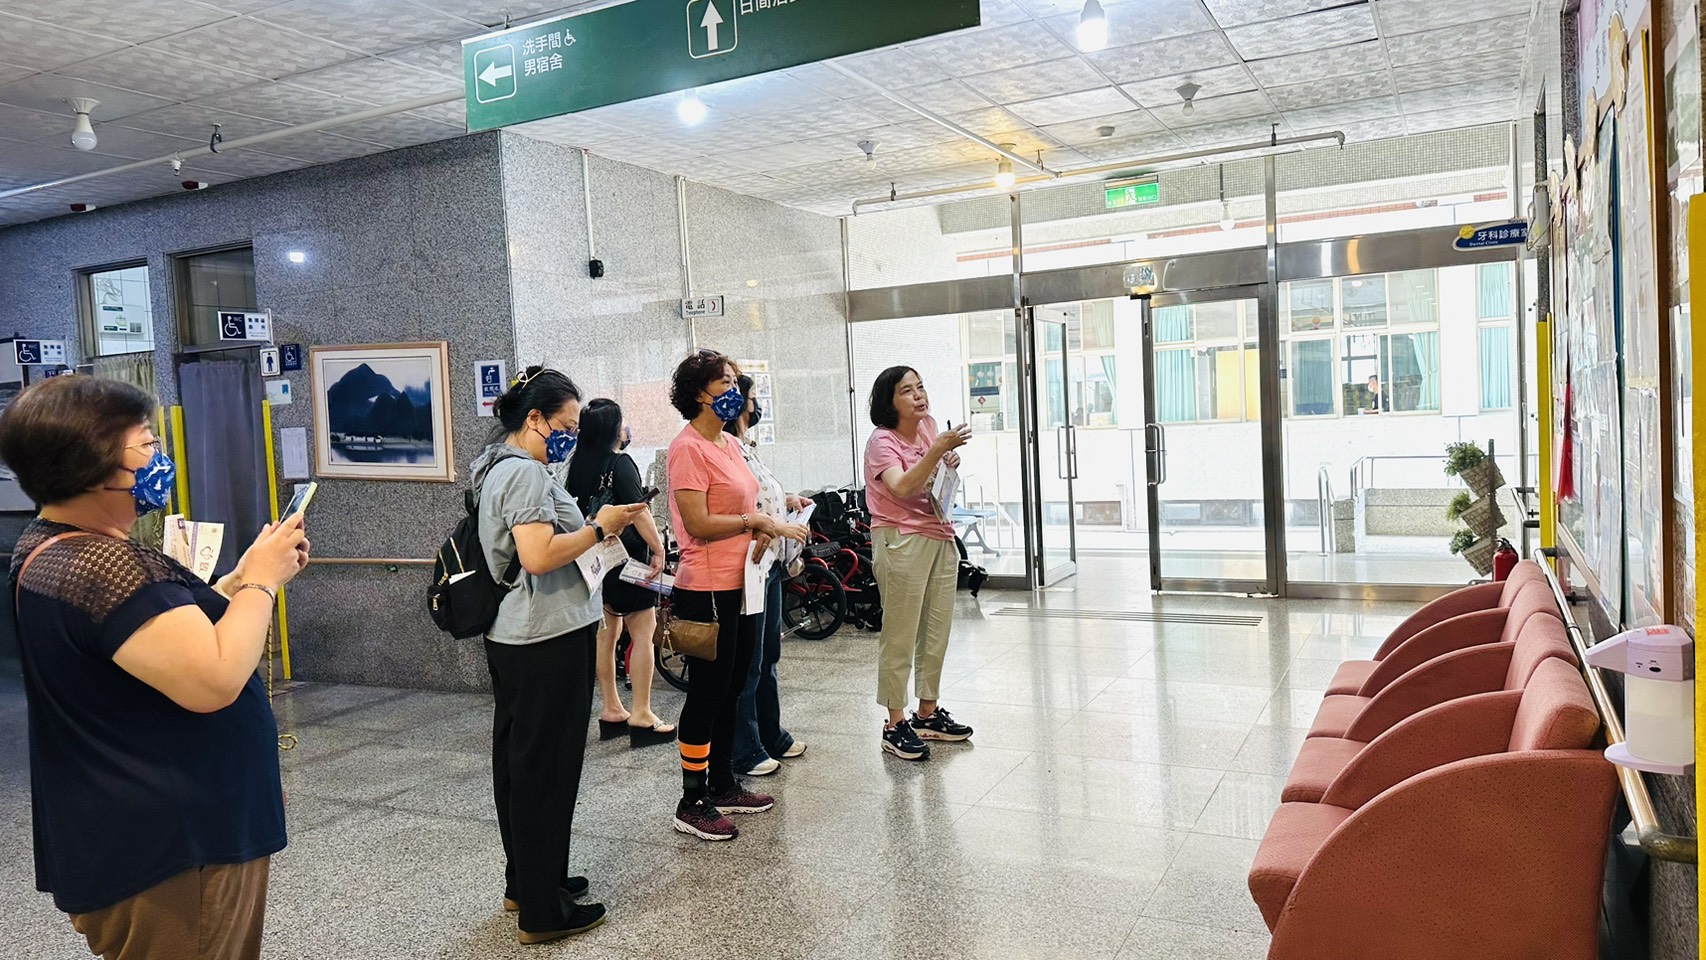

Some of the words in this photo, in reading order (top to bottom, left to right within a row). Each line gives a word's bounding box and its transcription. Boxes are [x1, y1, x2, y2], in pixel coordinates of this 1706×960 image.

[523, 31, 561, 55] 洗手間
[525, 53, 562, 76] 男宿舍
